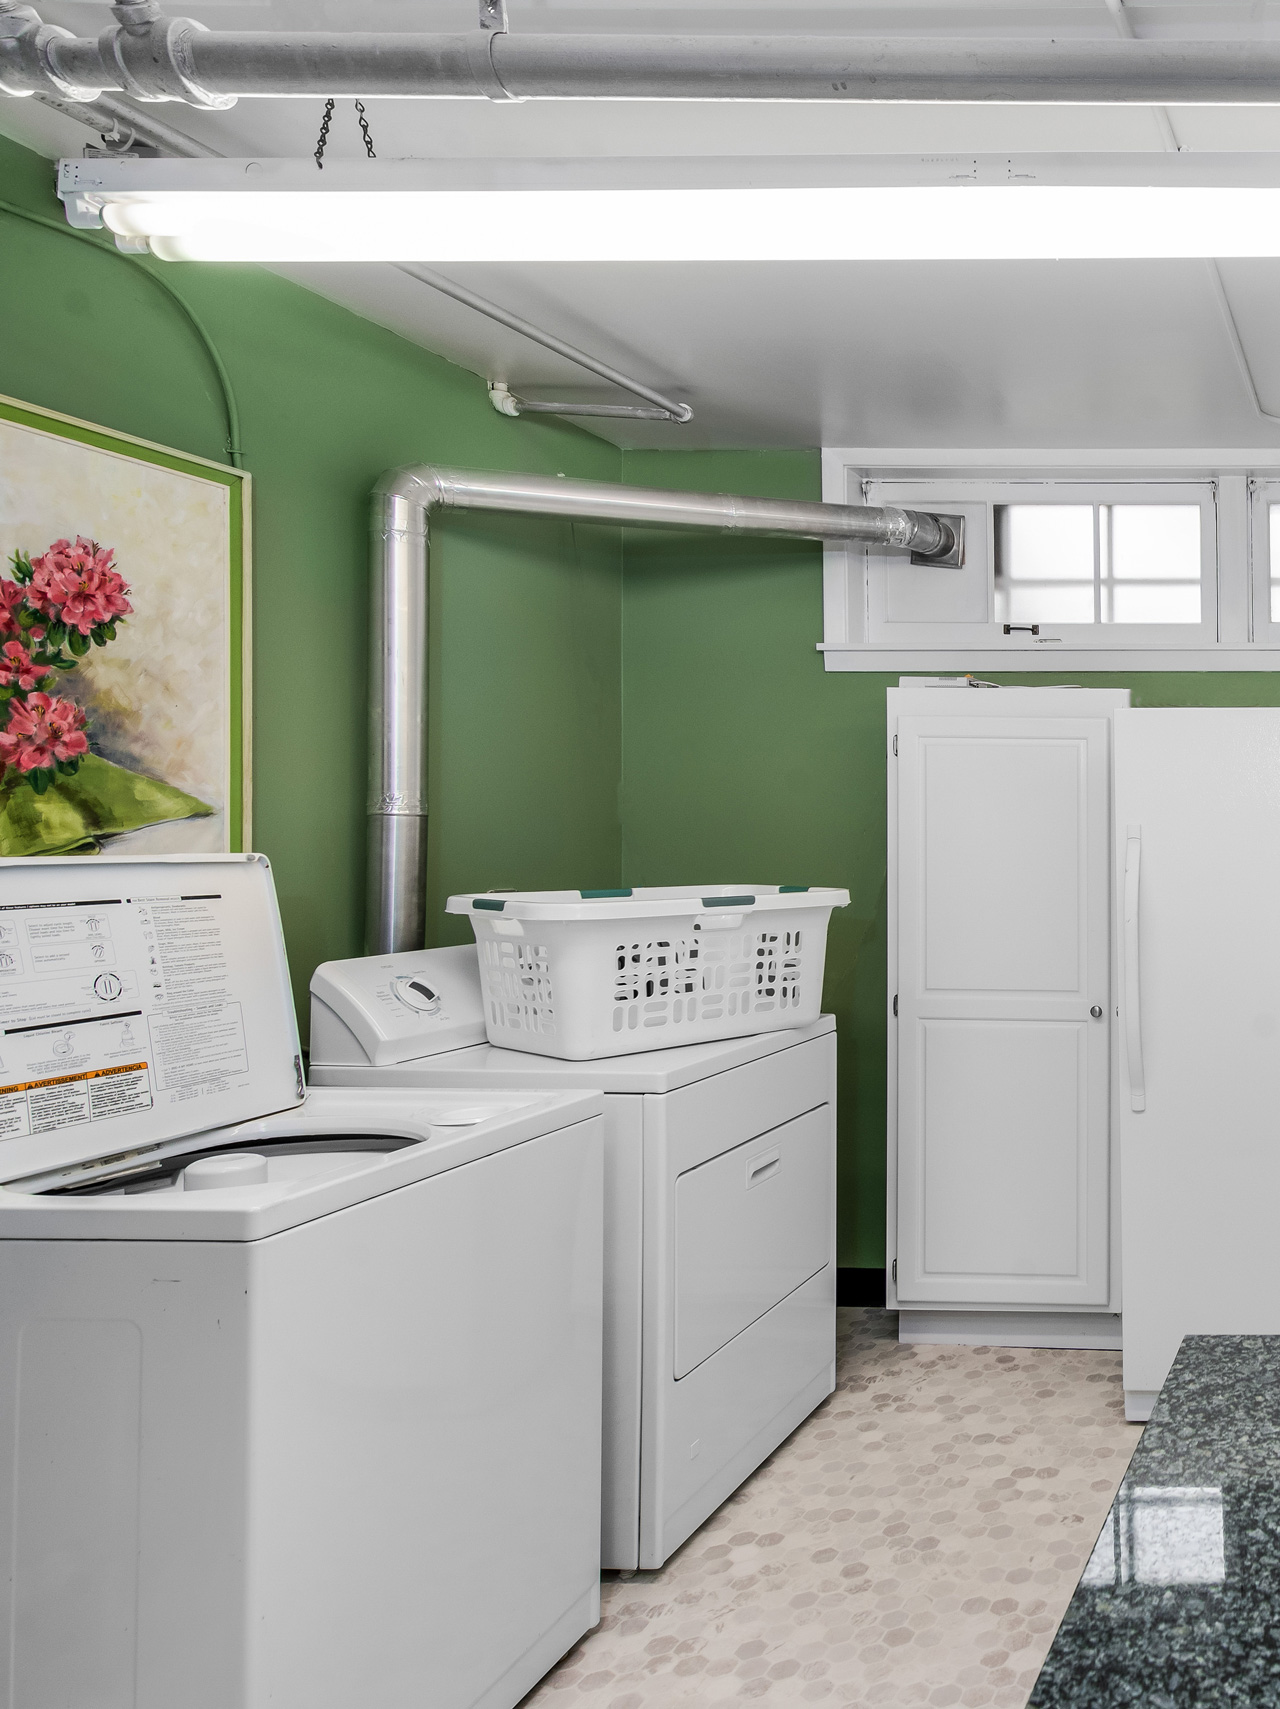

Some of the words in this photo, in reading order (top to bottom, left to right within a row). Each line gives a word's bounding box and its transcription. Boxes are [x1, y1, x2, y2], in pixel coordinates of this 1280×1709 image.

[101, 1064, 142, 1076] ADVERTENCIA
[34, 1074, 86, 1089] AVERTISSEMENT
[0, 1086, 18, 1094] NING
